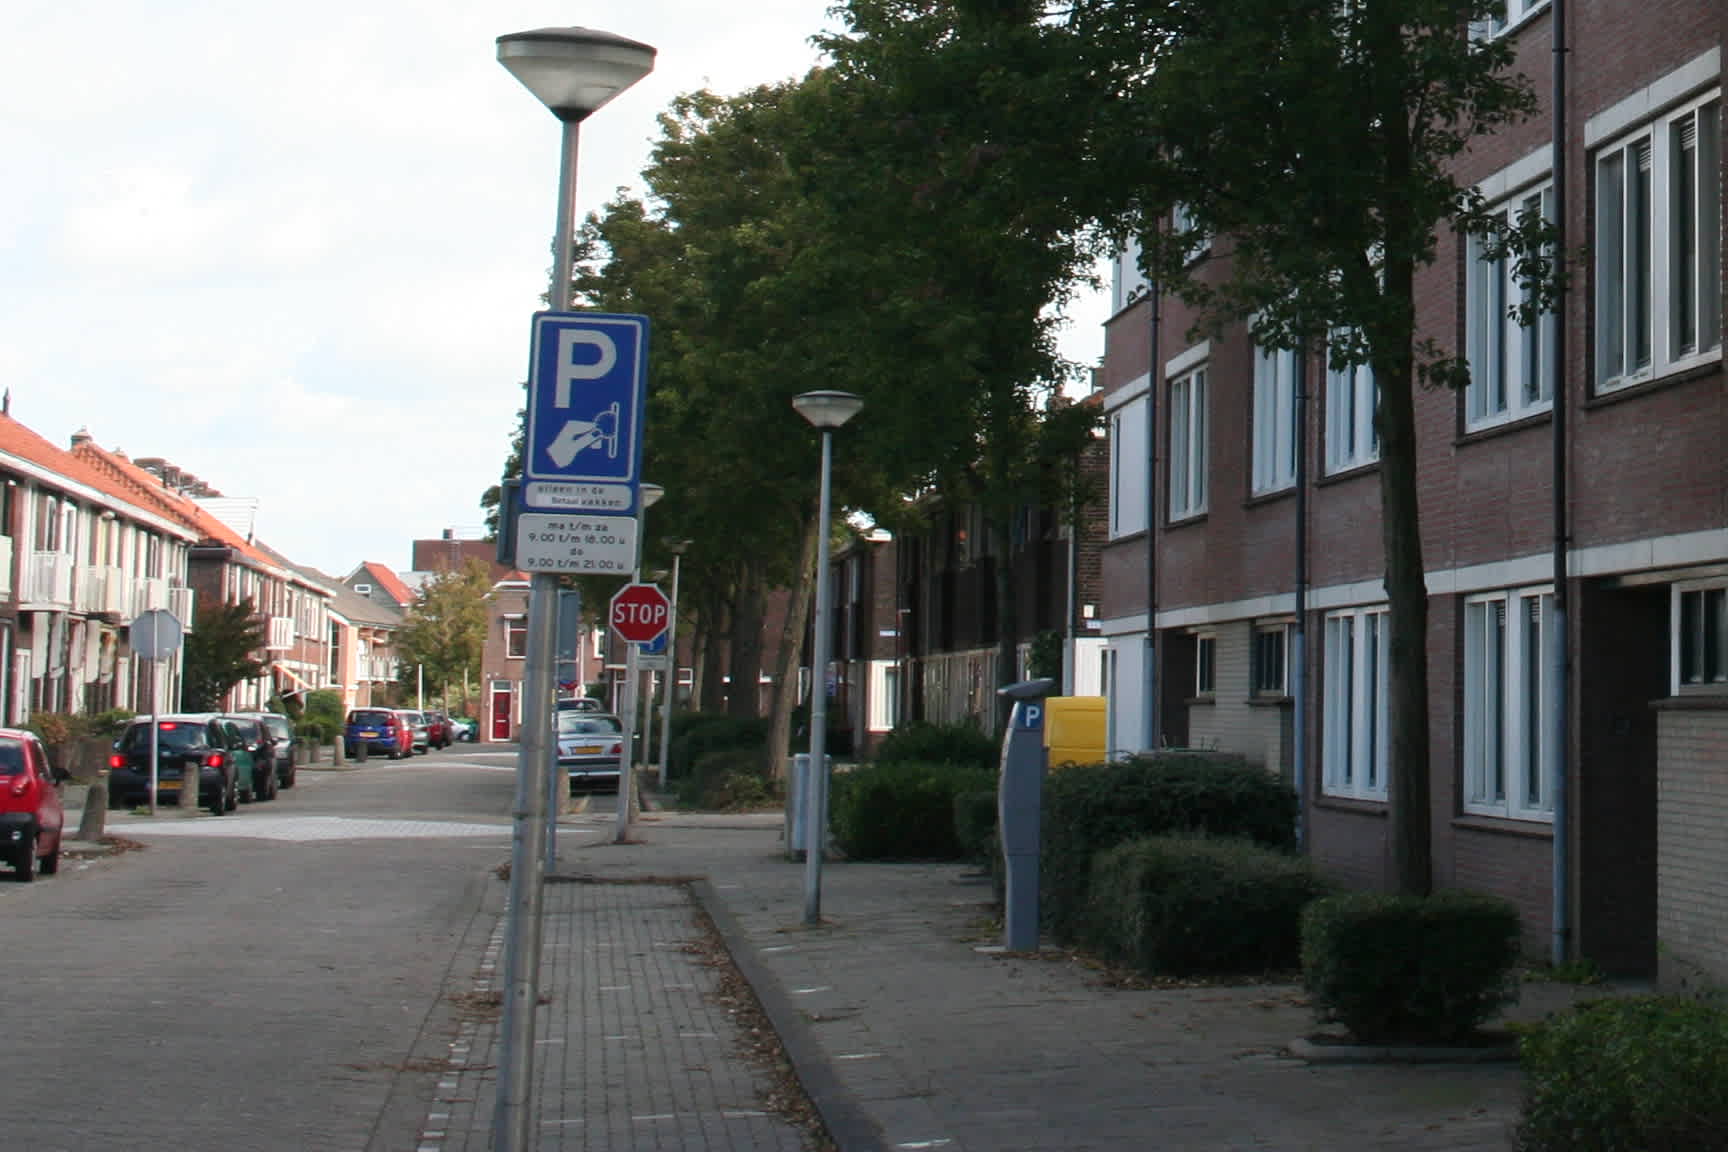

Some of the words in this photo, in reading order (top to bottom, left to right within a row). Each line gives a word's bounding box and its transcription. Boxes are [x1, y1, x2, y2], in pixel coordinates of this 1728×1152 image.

[554, 328, 617, 408] P
[569, 522, 592, 531] t/m
[528, 533, 555, 543] 9.00
[560, 534, 581, 544] t/m
[528, 558, 554, 568] 9.00
[558, 559, 580, 568] t/m
[614, 603, 665, 625] STOP
[1026, 706, 1040, 727] P
